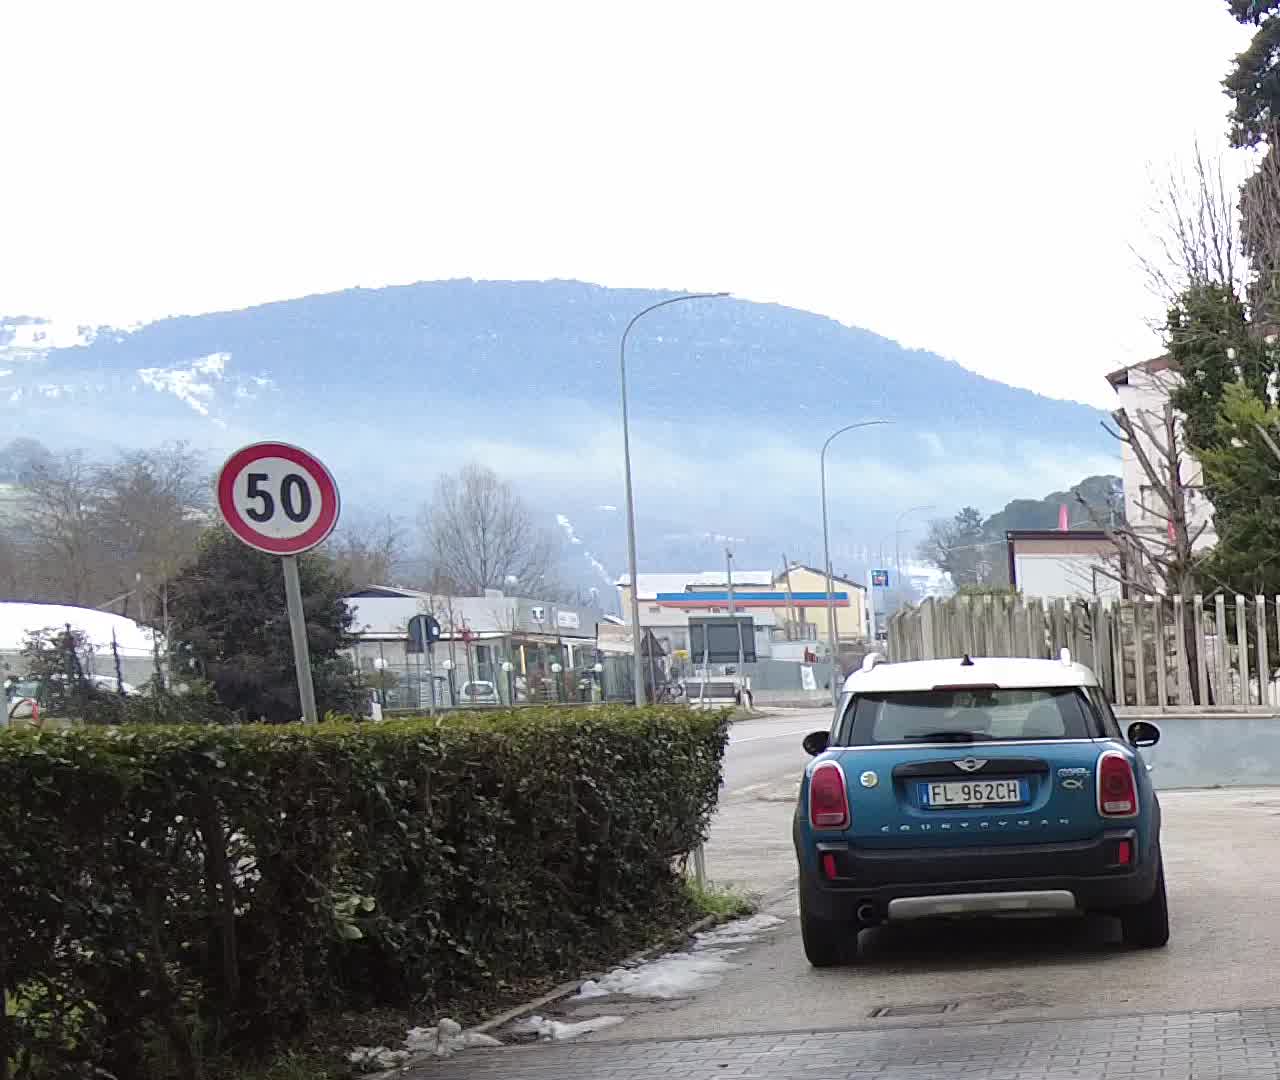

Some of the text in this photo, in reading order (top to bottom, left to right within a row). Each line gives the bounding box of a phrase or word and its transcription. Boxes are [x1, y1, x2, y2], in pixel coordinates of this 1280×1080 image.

[246, 473, 312, 523] 50
[932, 783, 1017, 802] FL 962CH
